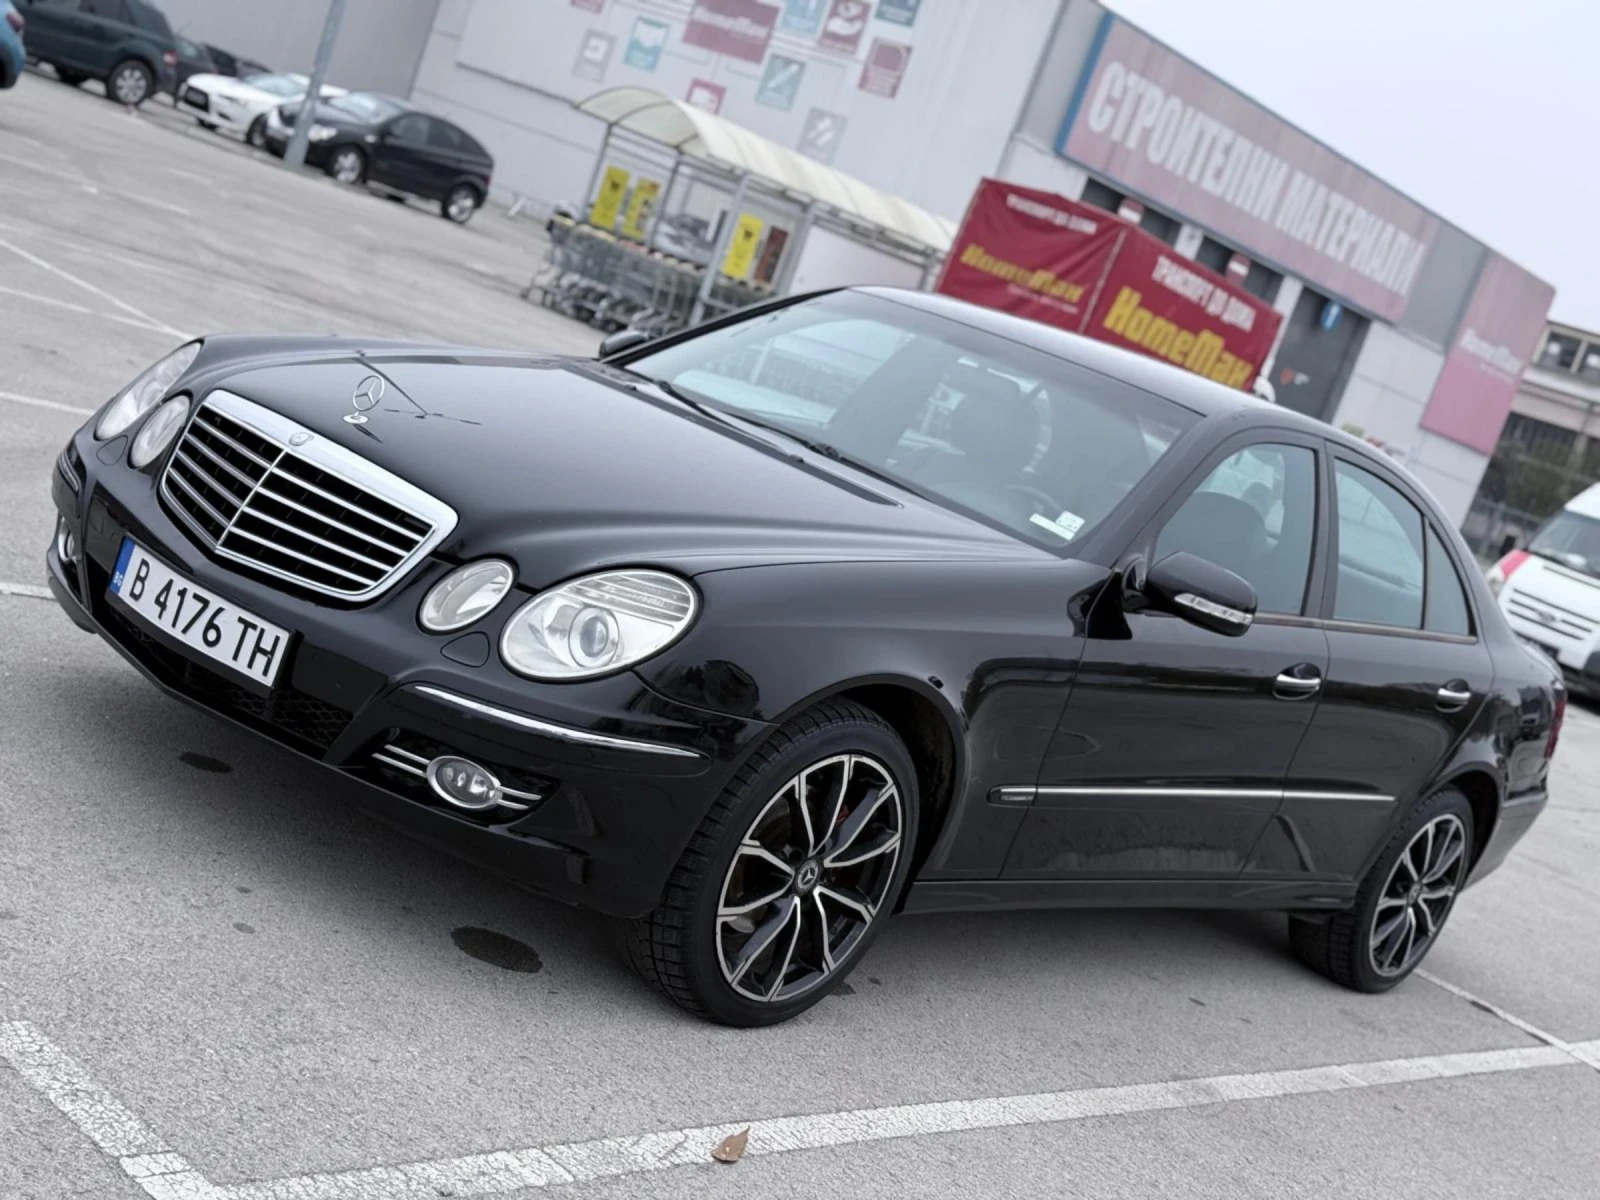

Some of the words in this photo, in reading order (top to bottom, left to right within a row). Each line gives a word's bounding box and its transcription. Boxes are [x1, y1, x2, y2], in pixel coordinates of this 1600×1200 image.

[1088, 61, 1289, 222] СТРОИТЕЛНИ
[1275, 169, 1425, 297] МАТЕРИАЛИ
[1103, 286, 1254, 389] HomeMax
[129, 558, 150, 602] B
[154, 578, 226, 648] 4176
[232, 616, 281, 677] TH
